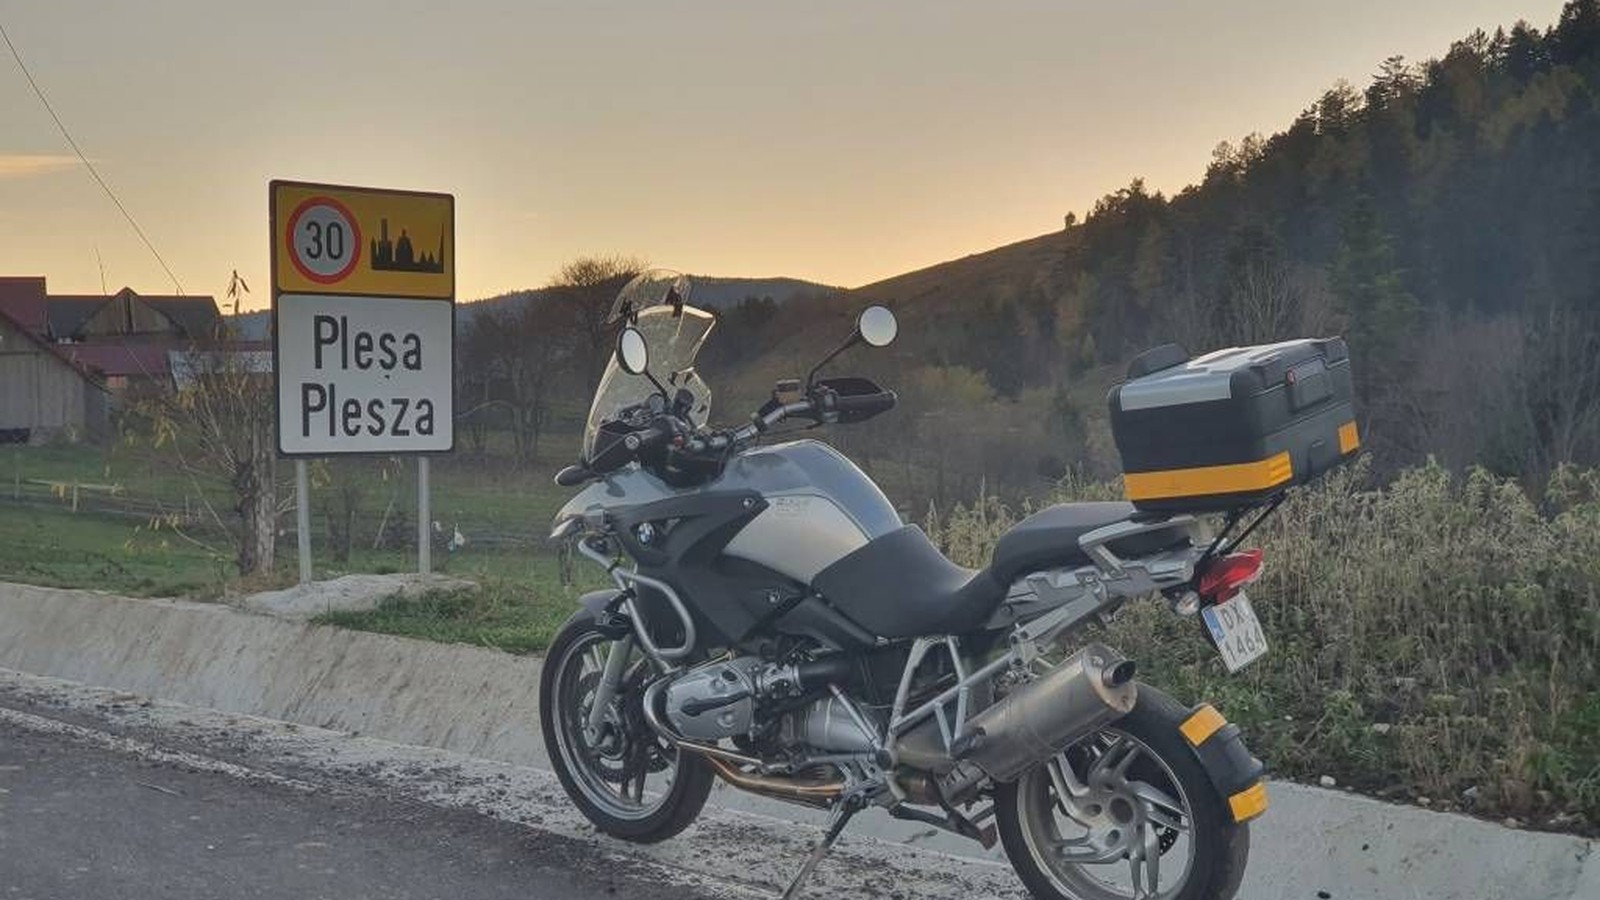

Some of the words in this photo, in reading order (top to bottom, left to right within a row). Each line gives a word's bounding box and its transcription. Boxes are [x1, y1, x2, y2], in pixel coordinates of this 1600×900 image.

[305, 220, 344, 260] 30
[313, 315, 422, 379] Pleșa
[301, 382, 434, 437] Plesza
